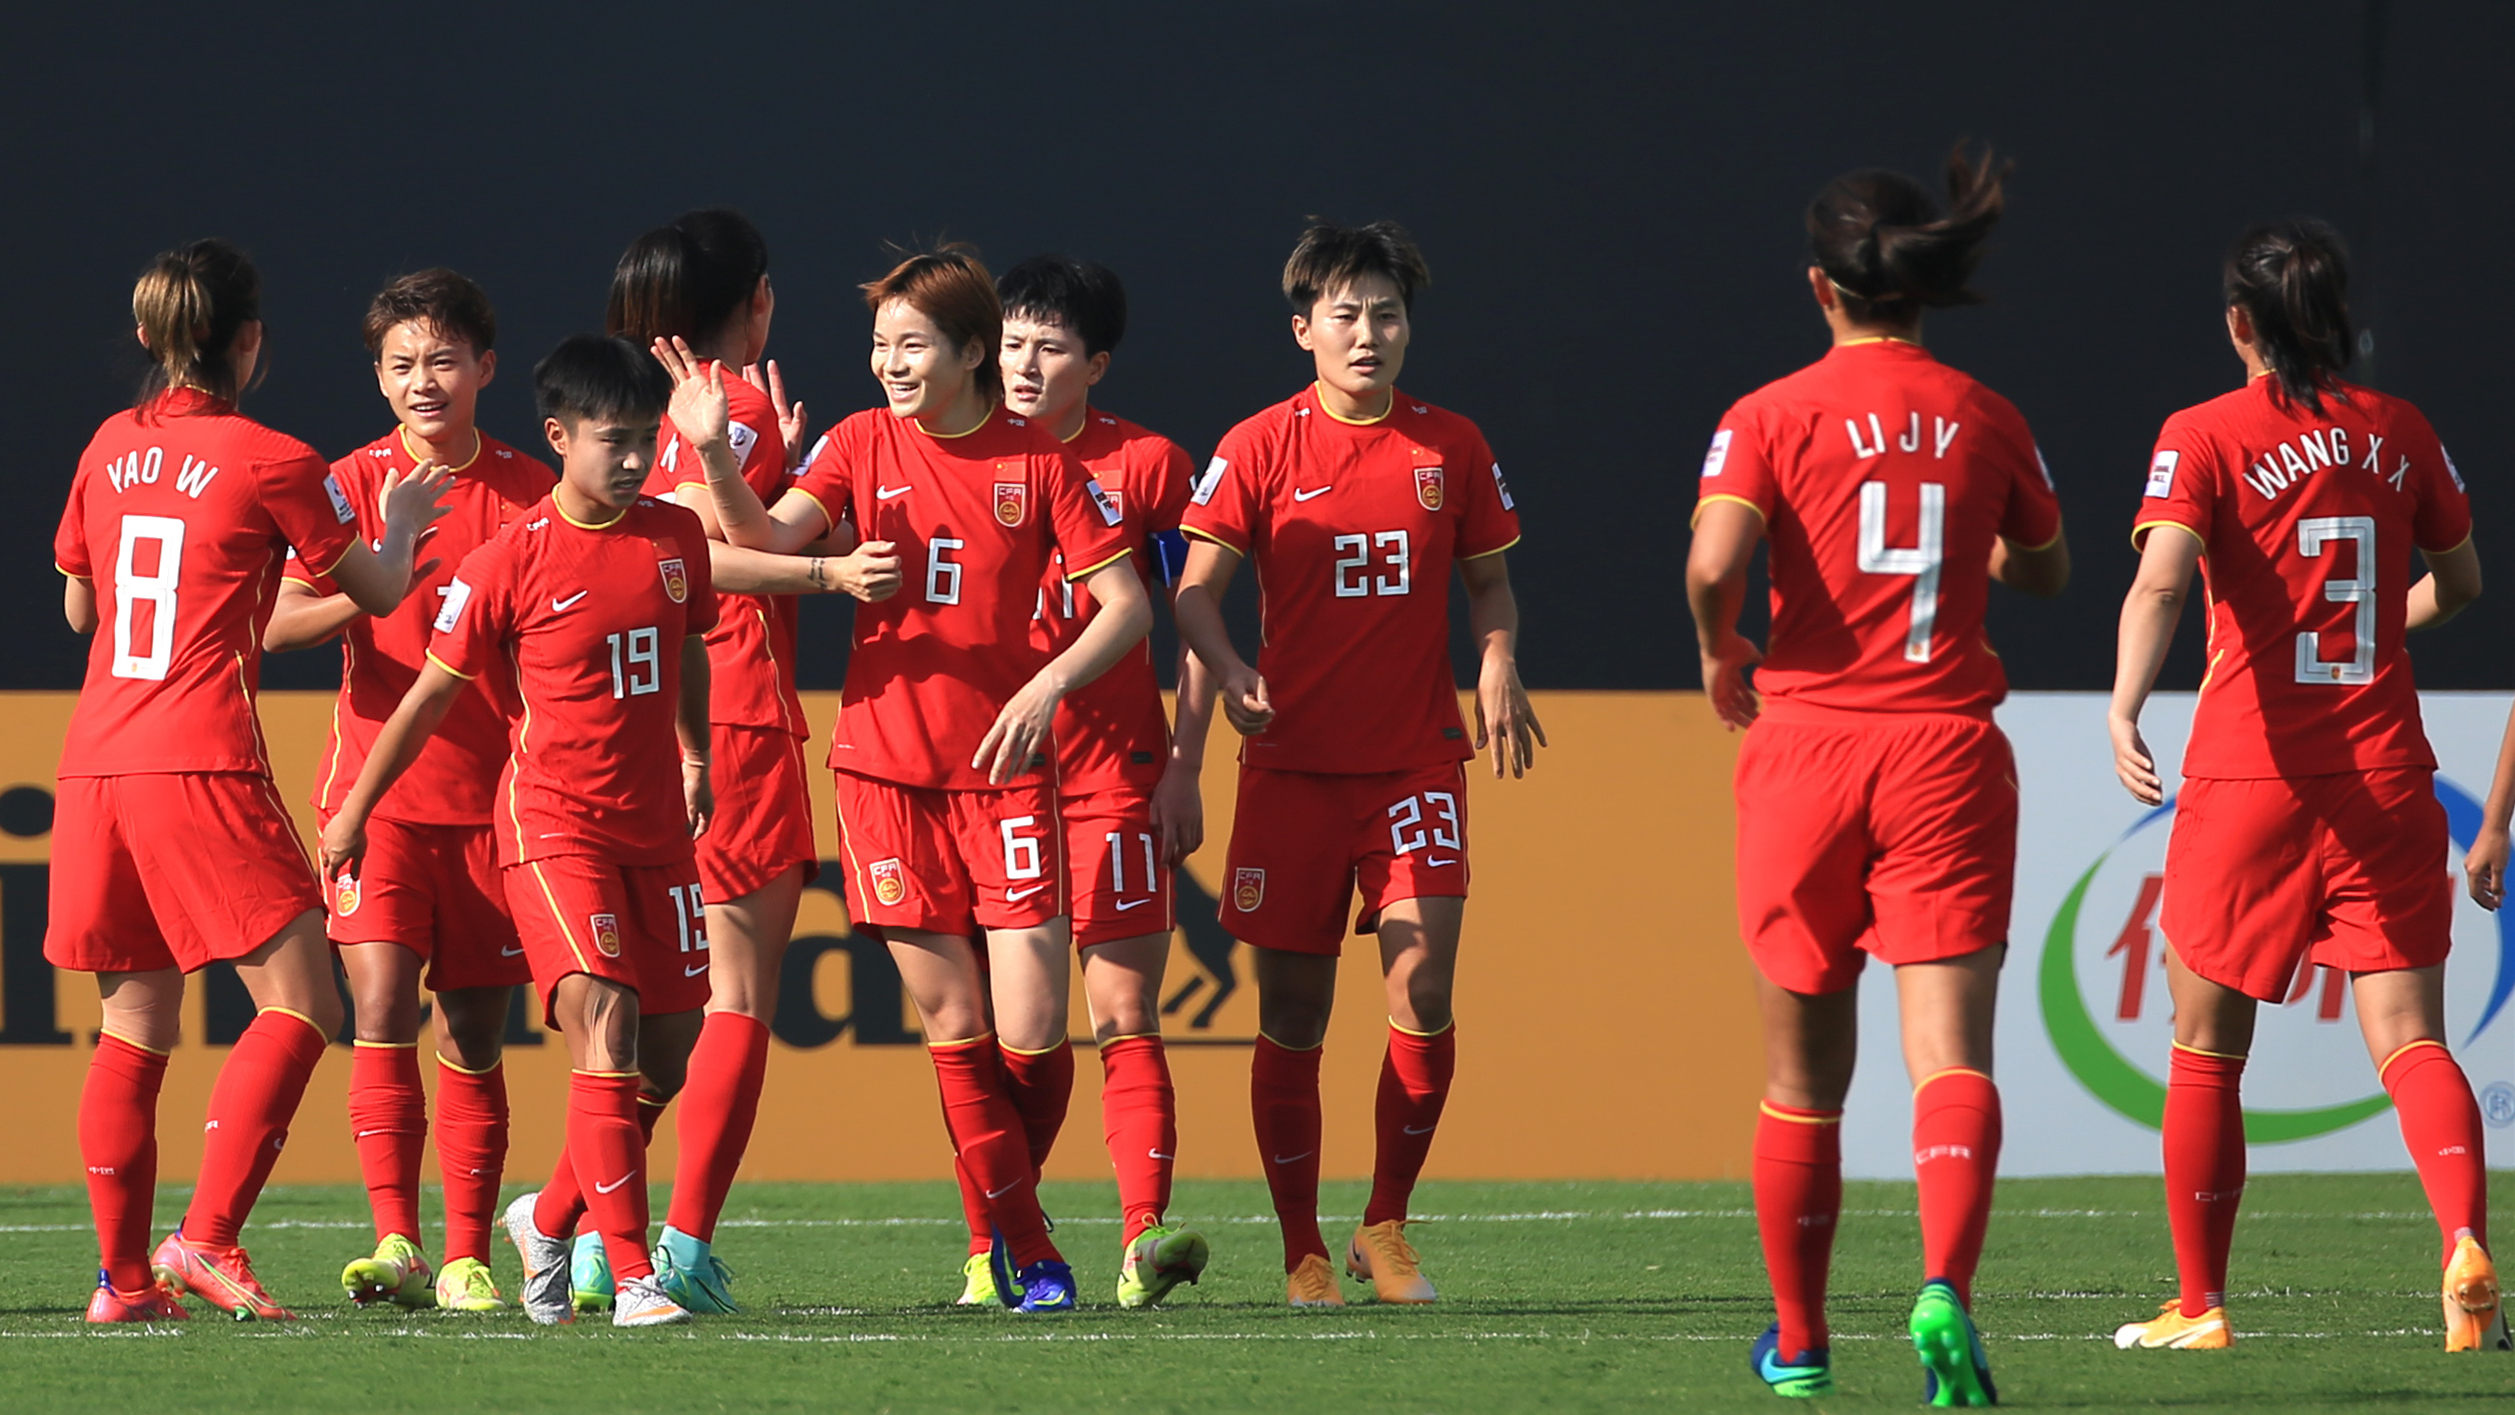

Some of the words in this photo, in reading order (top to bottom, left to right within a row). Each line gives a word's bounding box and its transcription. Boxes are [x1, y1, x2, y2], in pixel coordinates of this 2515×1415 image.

[1846, 413, 1886, 459] LI
[2243, 428, 2351, 501] WANG
[107, 447, 164, 495] YAO
[176, 455, 220, 500] W
[112, 514, 186, 681] 8
[926, 537, 964, 606] 6
[1334, 530, 1410, 597] 23
[1858, 481, 1945, 664] 4
[2295, 516, 2377, 685] 3
[606, 626, 660, 700] 19
[1000, 815, 1041, 880] 6
[1388, 791, 1461, 856] 23
[1106, 832, 1156, 892] 11
